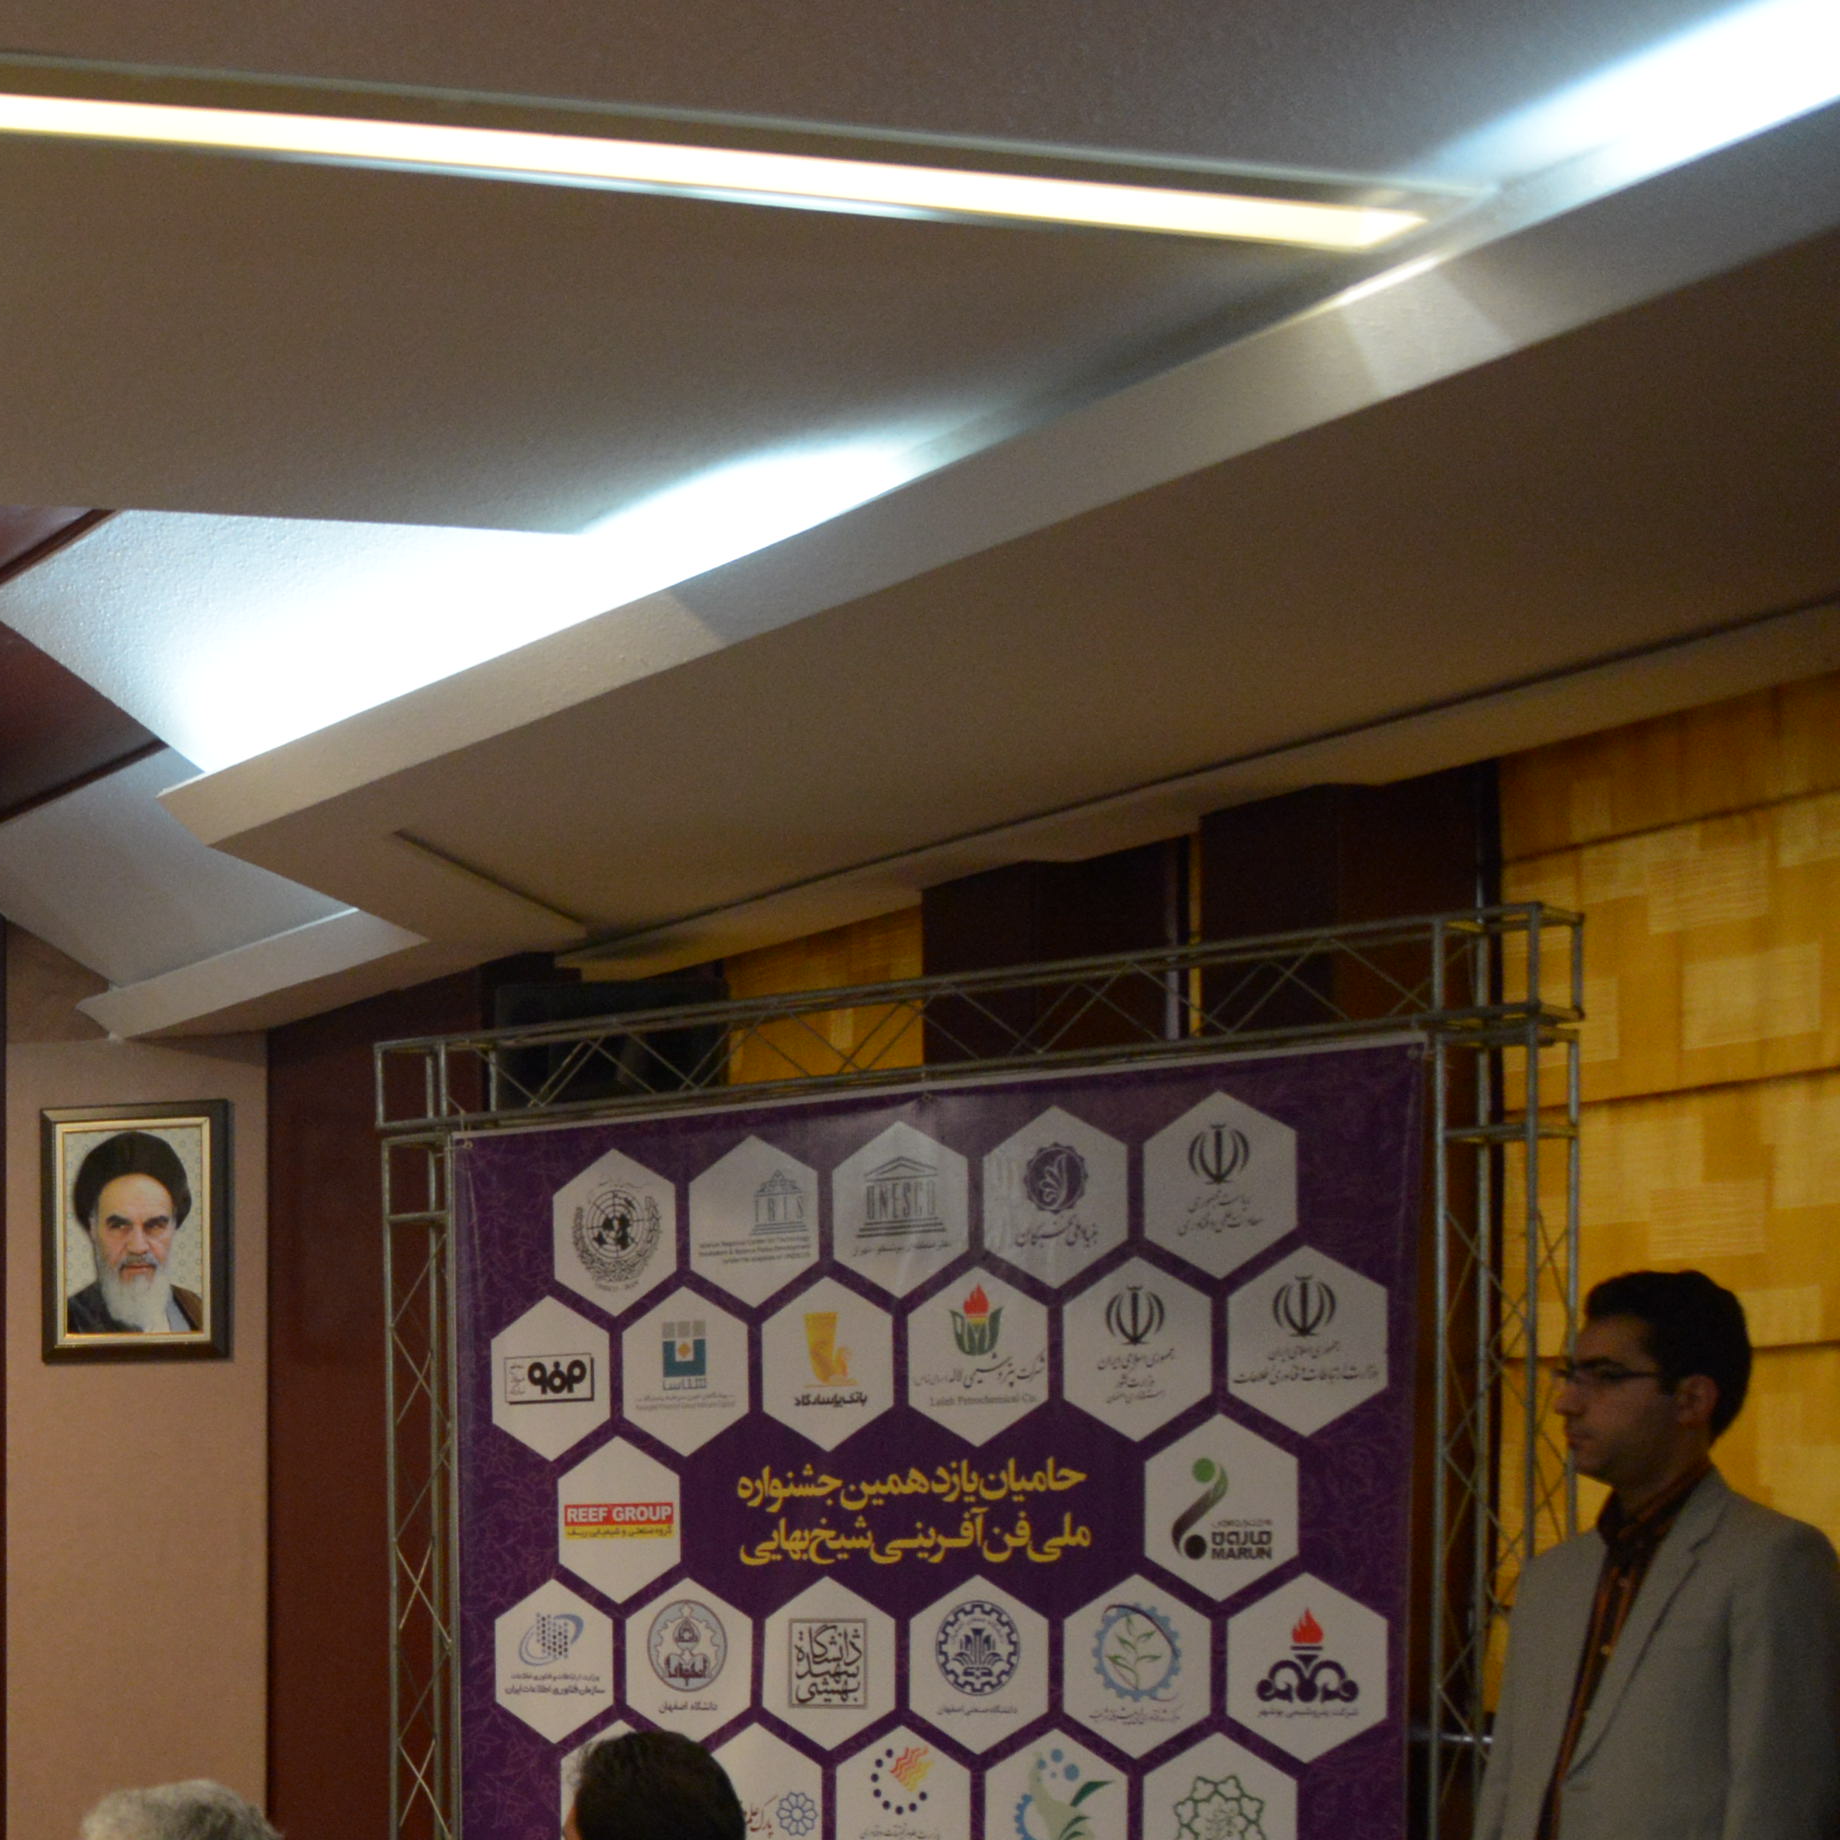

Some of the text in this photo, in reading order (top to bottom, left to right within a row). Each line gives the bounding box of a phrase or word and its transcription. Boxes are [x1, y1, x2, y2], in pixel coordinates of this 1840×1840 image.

[864, 1179, 938, 1221] UNESCO
[737, 1455, 1088, 1513] حامیان یازدهمین جشنواره
[566, 1504, 673, 1523] REEF GROUP
[1027, 1512, 1092, 1563] ملی
[739, 1517, 811, 1566] بهایی
[808, 1515, 873, 1565] شیخ
[1210, 1546, 1273, 1561] MARUN
